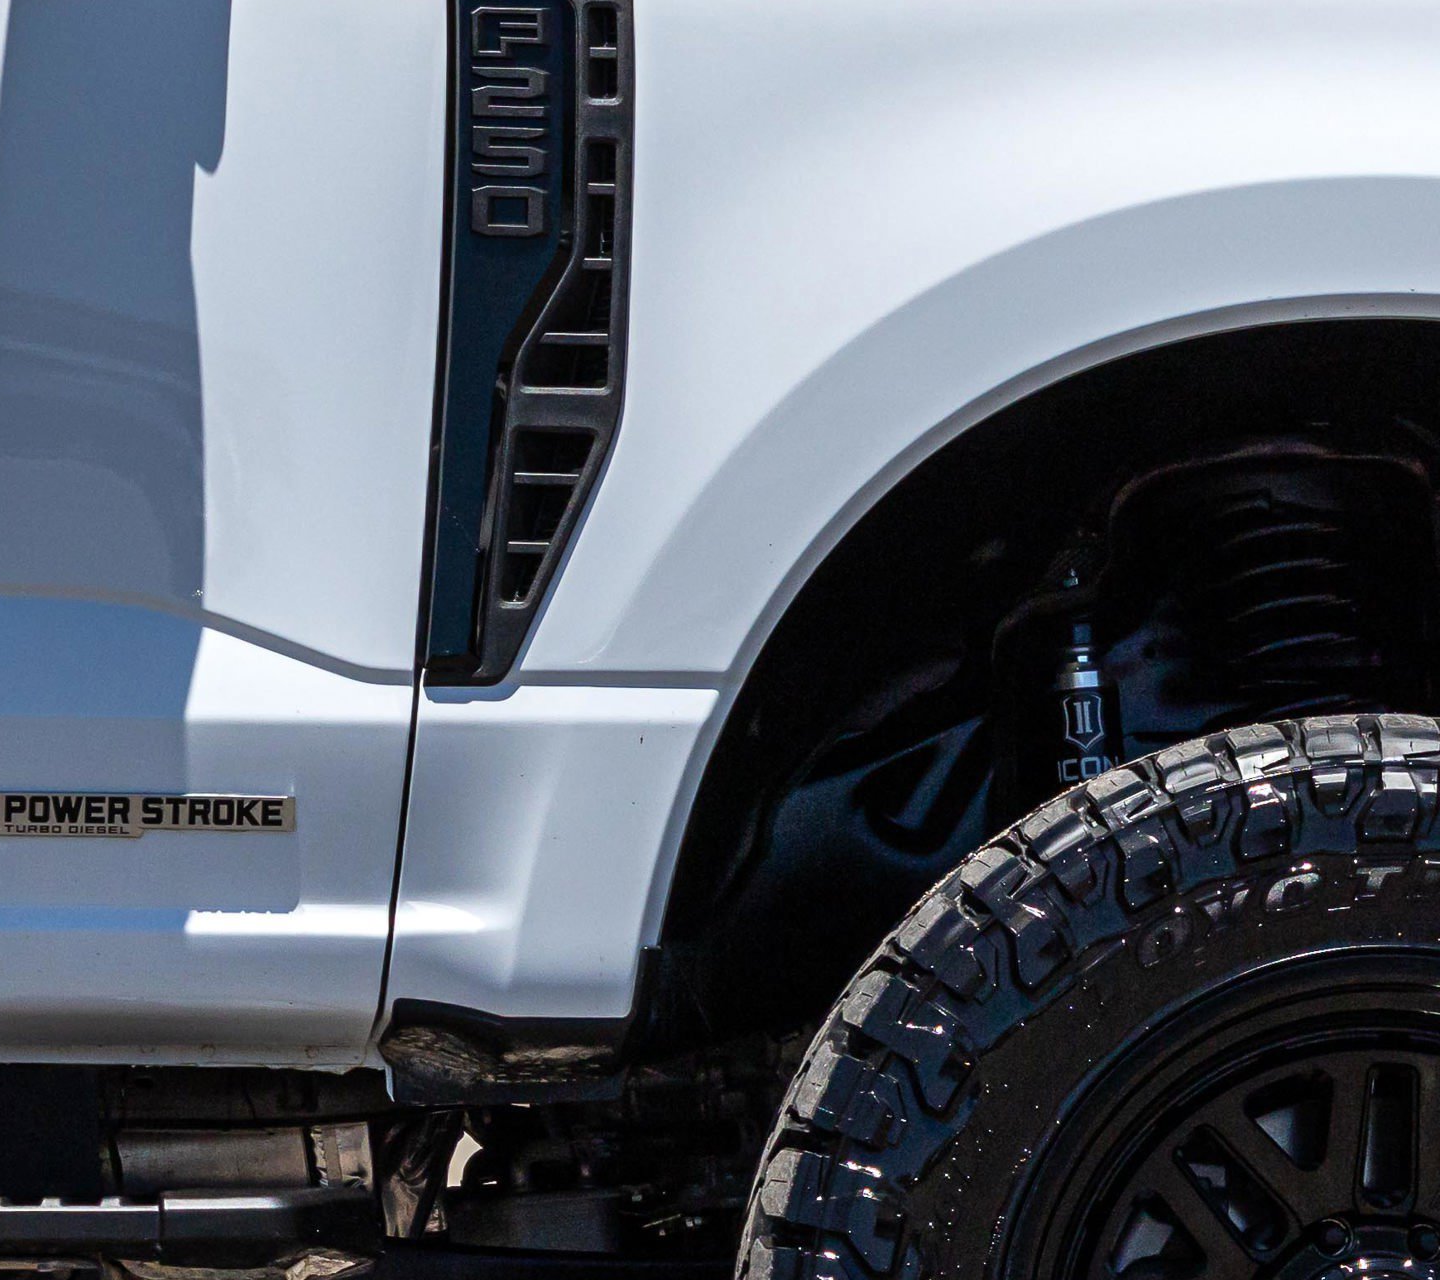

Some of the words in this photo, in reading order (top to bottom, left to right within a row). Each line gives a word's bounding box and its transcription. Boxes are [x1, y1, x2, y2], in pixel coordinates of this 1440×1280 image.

[4, 795, 130, 824] POWER
[140, 797, 284, 827] STROKE
[4, 824, 62, 835] TURBO
[68, 824, 130, 835] DIESEL
